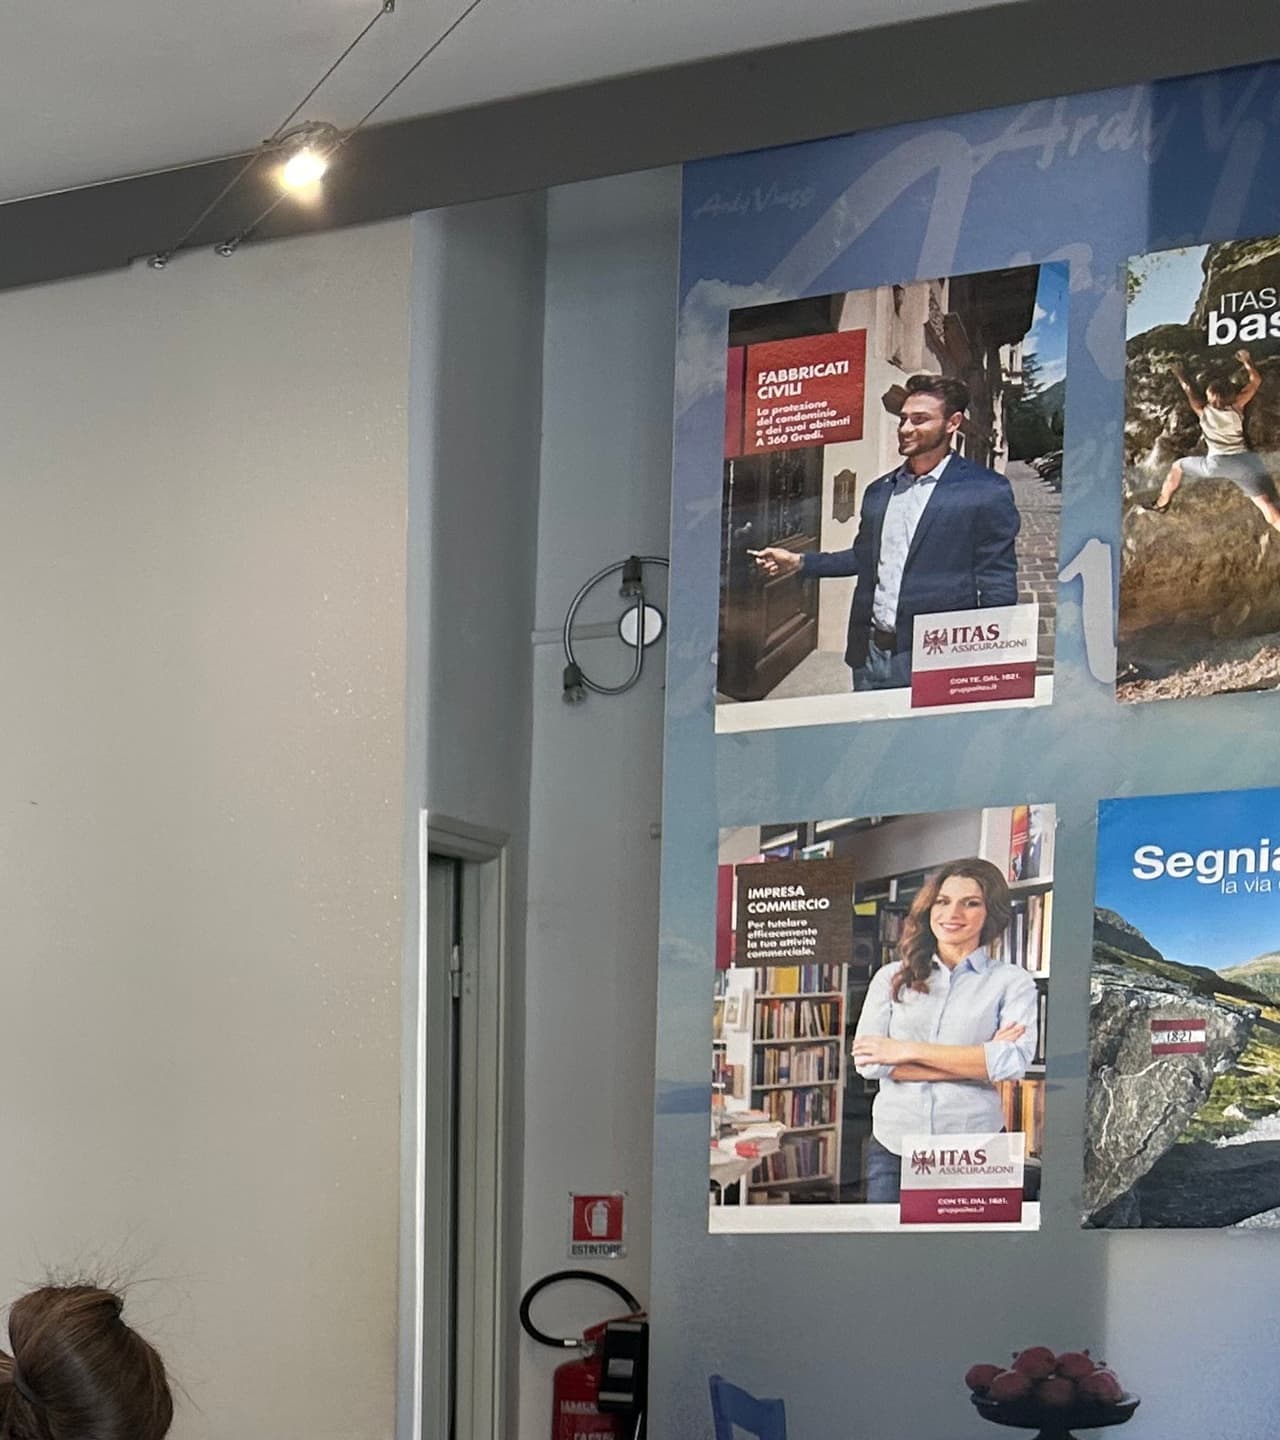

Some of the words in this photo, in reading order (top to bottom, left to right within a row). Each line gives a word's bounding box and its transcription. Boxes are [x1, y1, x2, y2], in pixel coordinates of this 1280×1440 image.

[1221, 287, 1277, 314] ITAS
[758, 360, 849, 385] FABBRICATI
[757, 382, 802, 399] CIVILI
[757, 407, 769, 416] La
[772, 401, 828, 416] protezione
[756, 416, 773, 427] del
[776, 408, 837, 423] condominio
[756, 429, 763, 437] e
[765, 425, 782, 435] dei
[785, 422, 807, 432] suoi
[809, 416, 850, 429] abitanti
[756, 438, 764, 447] A
[767, 435, 788, 446] 360
[791, 430, 824, 442] Gradi.
[951, 624, 1000, 644] ITAS
[951, 639, 1028, 654] ASSICURAZIONI
[747, 885, 805, 900] IMPRESA
[1221, 878, 1238, 894] la
[1244, 875, 1272, 893] via
[747, 898, 830, 914] COMMERCIO
[747, 920, 765, 930] Per
[767, 918, 808, 929] tutelare
[747, 928, 818, 940] efficacemente
[747, 939, 757, 949] la
[760, 940, 777, 948] tua
[939, 1148, 987, 1166] ITAS
[939, 1164, 1014, 1176] ASSICURAZIONI
